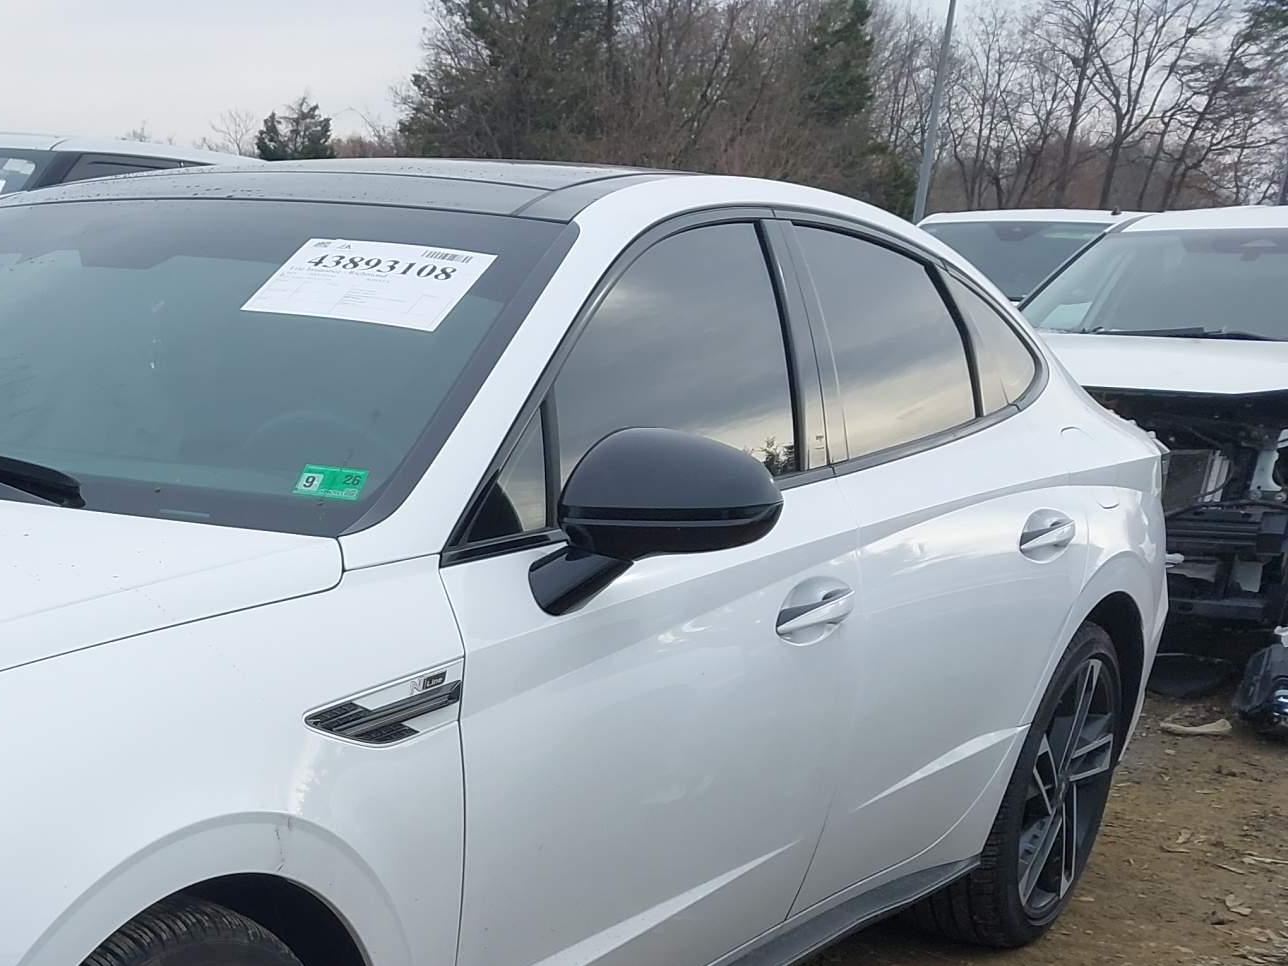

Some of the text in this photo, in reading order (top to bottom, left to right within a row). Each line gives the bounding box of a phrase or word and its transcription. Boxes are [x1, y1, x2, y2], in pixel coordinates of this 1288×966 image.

[307, 254, 456, 281] 43893108
[303, 475, 362, 489] 9 26
